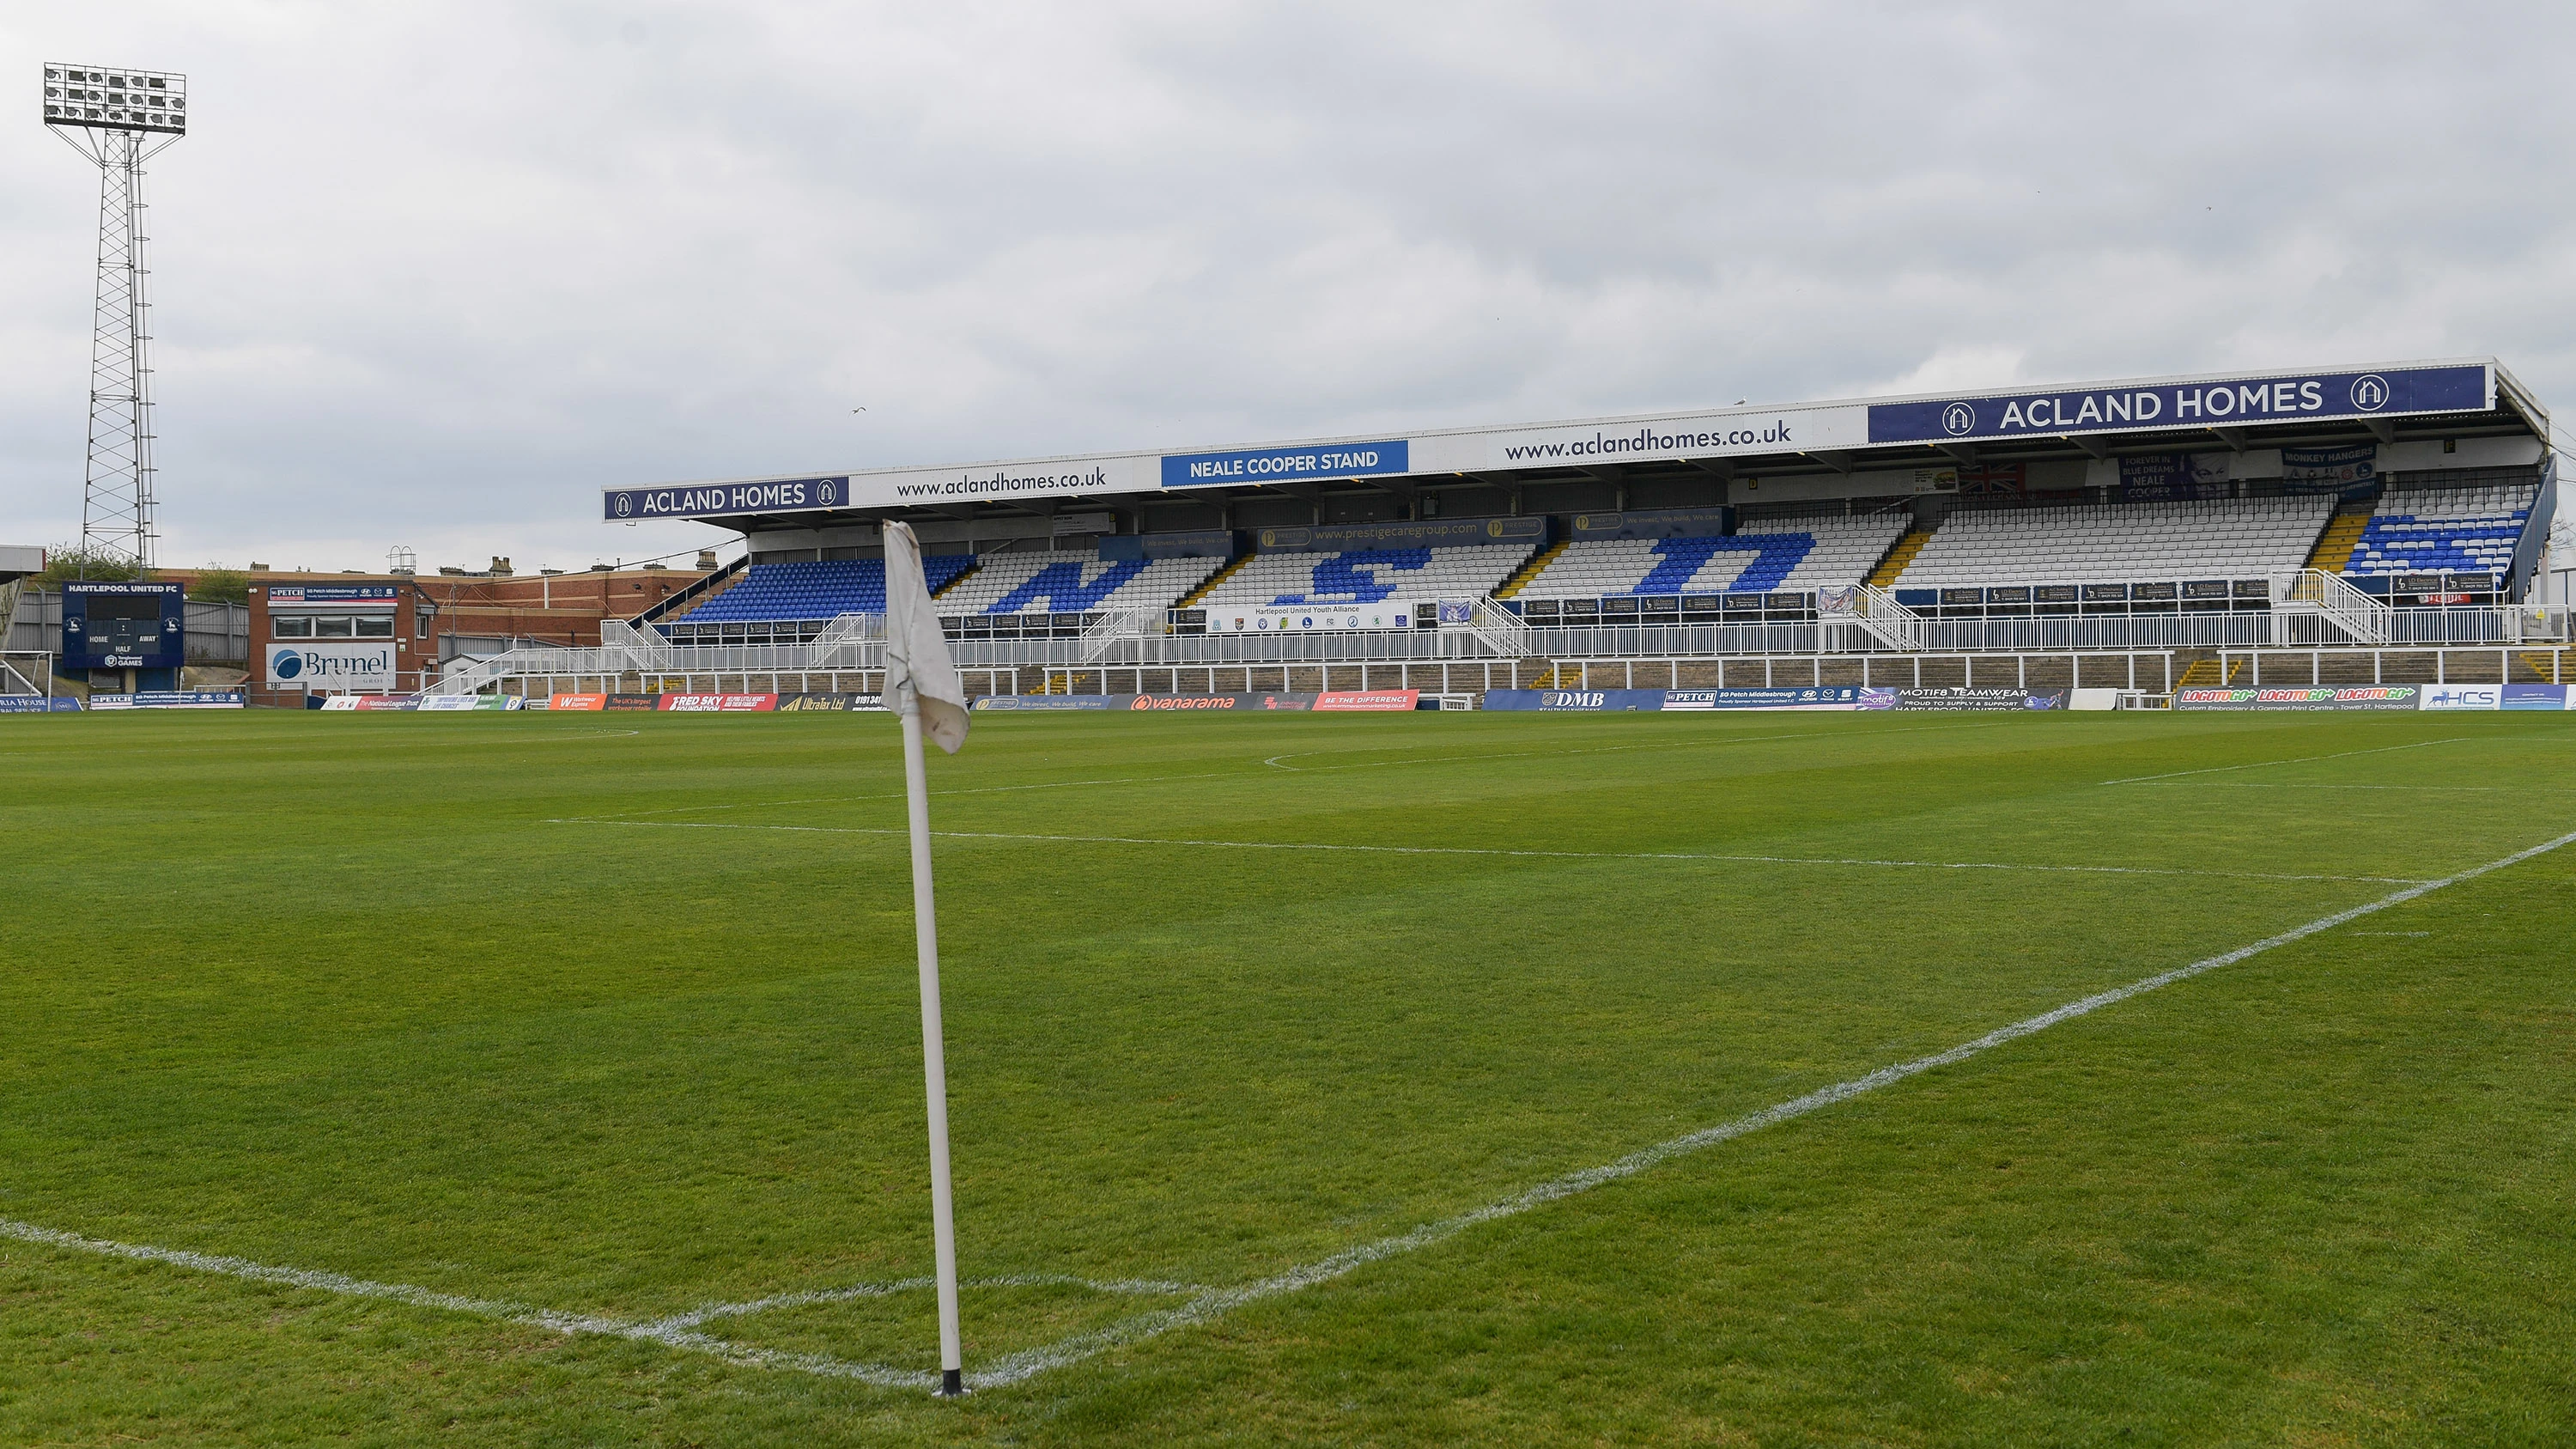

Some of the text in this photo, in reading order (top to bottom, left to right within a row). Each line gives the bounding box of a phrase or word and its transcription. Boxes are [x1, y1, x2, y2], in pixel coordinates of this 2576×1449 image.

[2000, 381, 2323, 429] ACLAND HOMES
[1505, 420, 1791, 460] www.aclandhomes.co.uk
[2125, 455, 2160, 465] FOREVER
[2285, 447, 2373, 462] MONKEY HANGERS
[1190, 451, 1379, 478] NEALE COOPER STAND
[2123, 465, 2175, 475] BLUE DREAMS
[896, 466, 1106, 496] www.aclandhomes.co.uk
[2133, 475, 2165, 486] NEALE
[643, 484, 805, 513] ACLAND HOMES
[1315, 522, 1478, 542] www.prestigecaregroup.com
[1255, 606, 1289, 616] Hartlepool
[1333, 605, 1359, 613] Alliance
[304, 650, 390, 676] Brunel
[680, 696, 724, 705] RED SKY
[854, 695, 870, 704] 0191
[1556, 692, 1605, 707] DMB
[1674, 692, 1716, 702] PETCH
[2181, 688, 2404, 702] LOGOTOGO LOGOTOGO LOGOTOGO
[2445, 691, 2494, 705] HCS
[802, 697, 846, 710] UltraTax Ltd
[1153, 697, 1236, 709] vanarama
